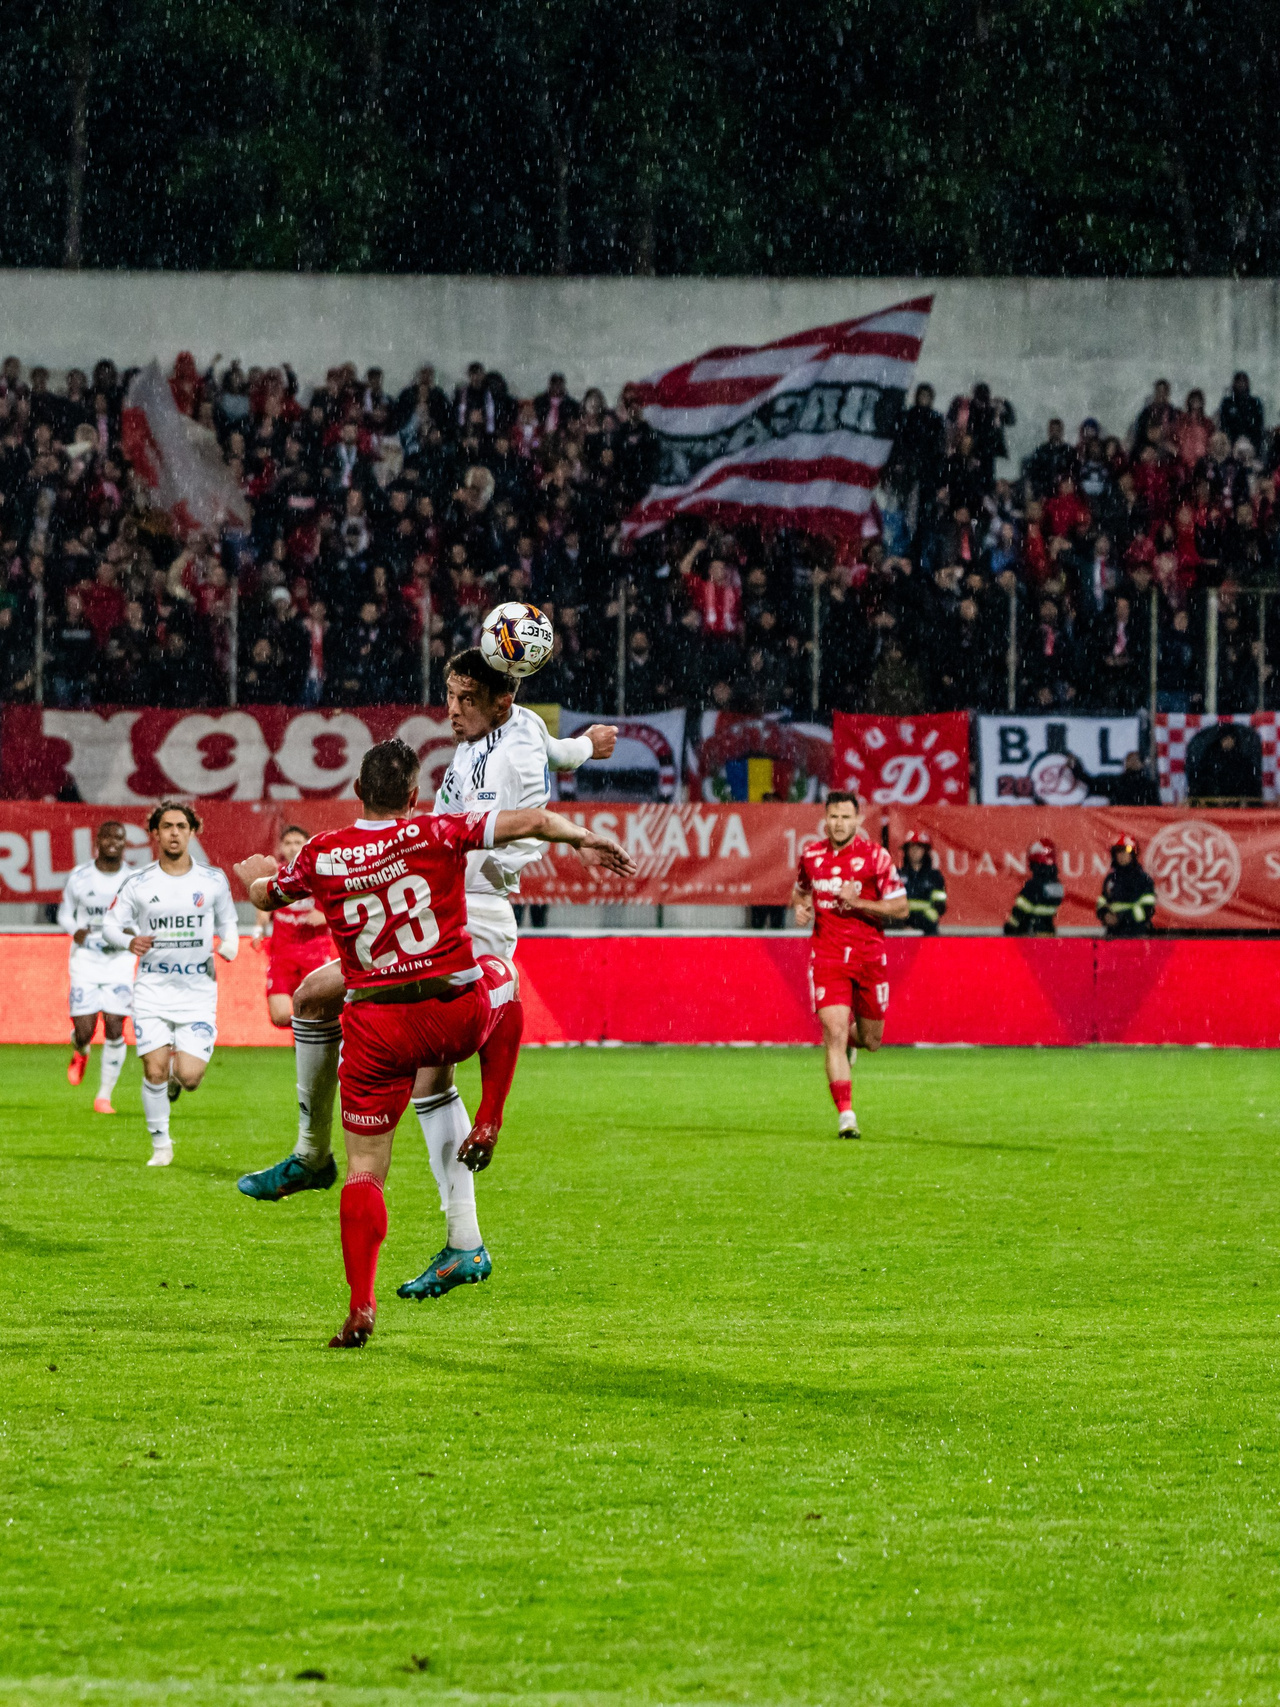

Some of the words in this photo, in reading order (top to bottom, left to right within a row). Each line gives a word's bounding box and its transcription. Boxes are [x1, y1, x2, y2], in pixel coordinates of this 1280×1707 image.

[931, 850, 1110, 877] UANUM
[344, 859, 409, 891] PATRICHE
[149, 915, 205, 930] UNIBET
[344, 874, 440, 971] 23
[142, 963, 208, 974] ELSACO
[381, 959, 433, 975] GAMING
[343, 1110, 390, 1126] CARPATINA
